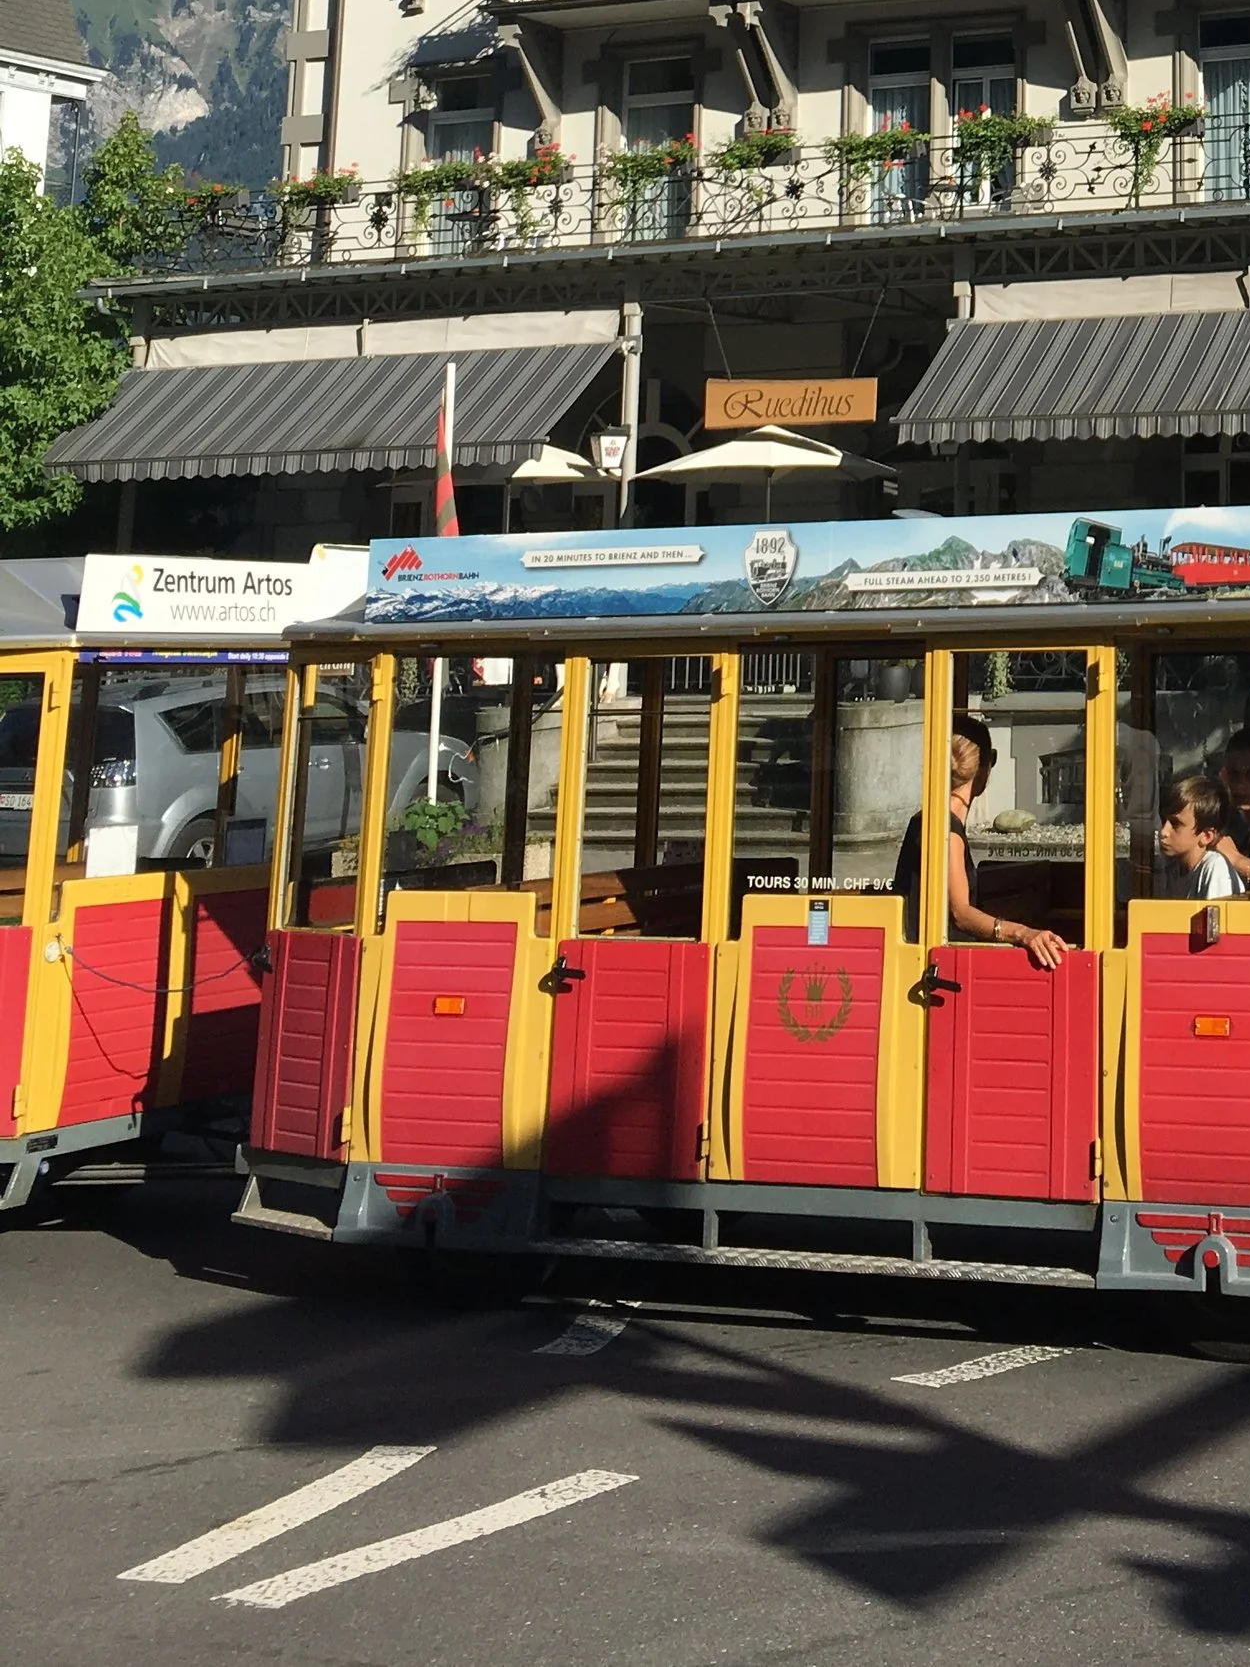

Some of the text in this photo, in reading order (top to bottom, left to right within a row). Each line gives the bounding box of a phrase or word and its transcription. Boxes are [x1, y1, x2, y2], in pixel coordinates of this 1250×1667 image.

[723, 386, 854, 420] Ruedihus
[756, 537, 786, 554] 1892
[531, 555, 541, 563] IN
[543, 554, 554, 562] 20
[556, 553, 592, 562] MINUTES
[595, 552, 606, 561] TO
[608, 551, 638, 560] BRIENZ
[640, 550, 659, 559] AND
[153, 567, 293, 597] Zentrum Artos
[886, 576, 914, 585] STEAM
[917, 575, 948, 584] AHEAD
[951, 574, 963, 583] TO
[170, 601, 276, 623] www.artos.ch
[747, 876, 894, 891] TOURS 30 MIN. CHF 9/€
